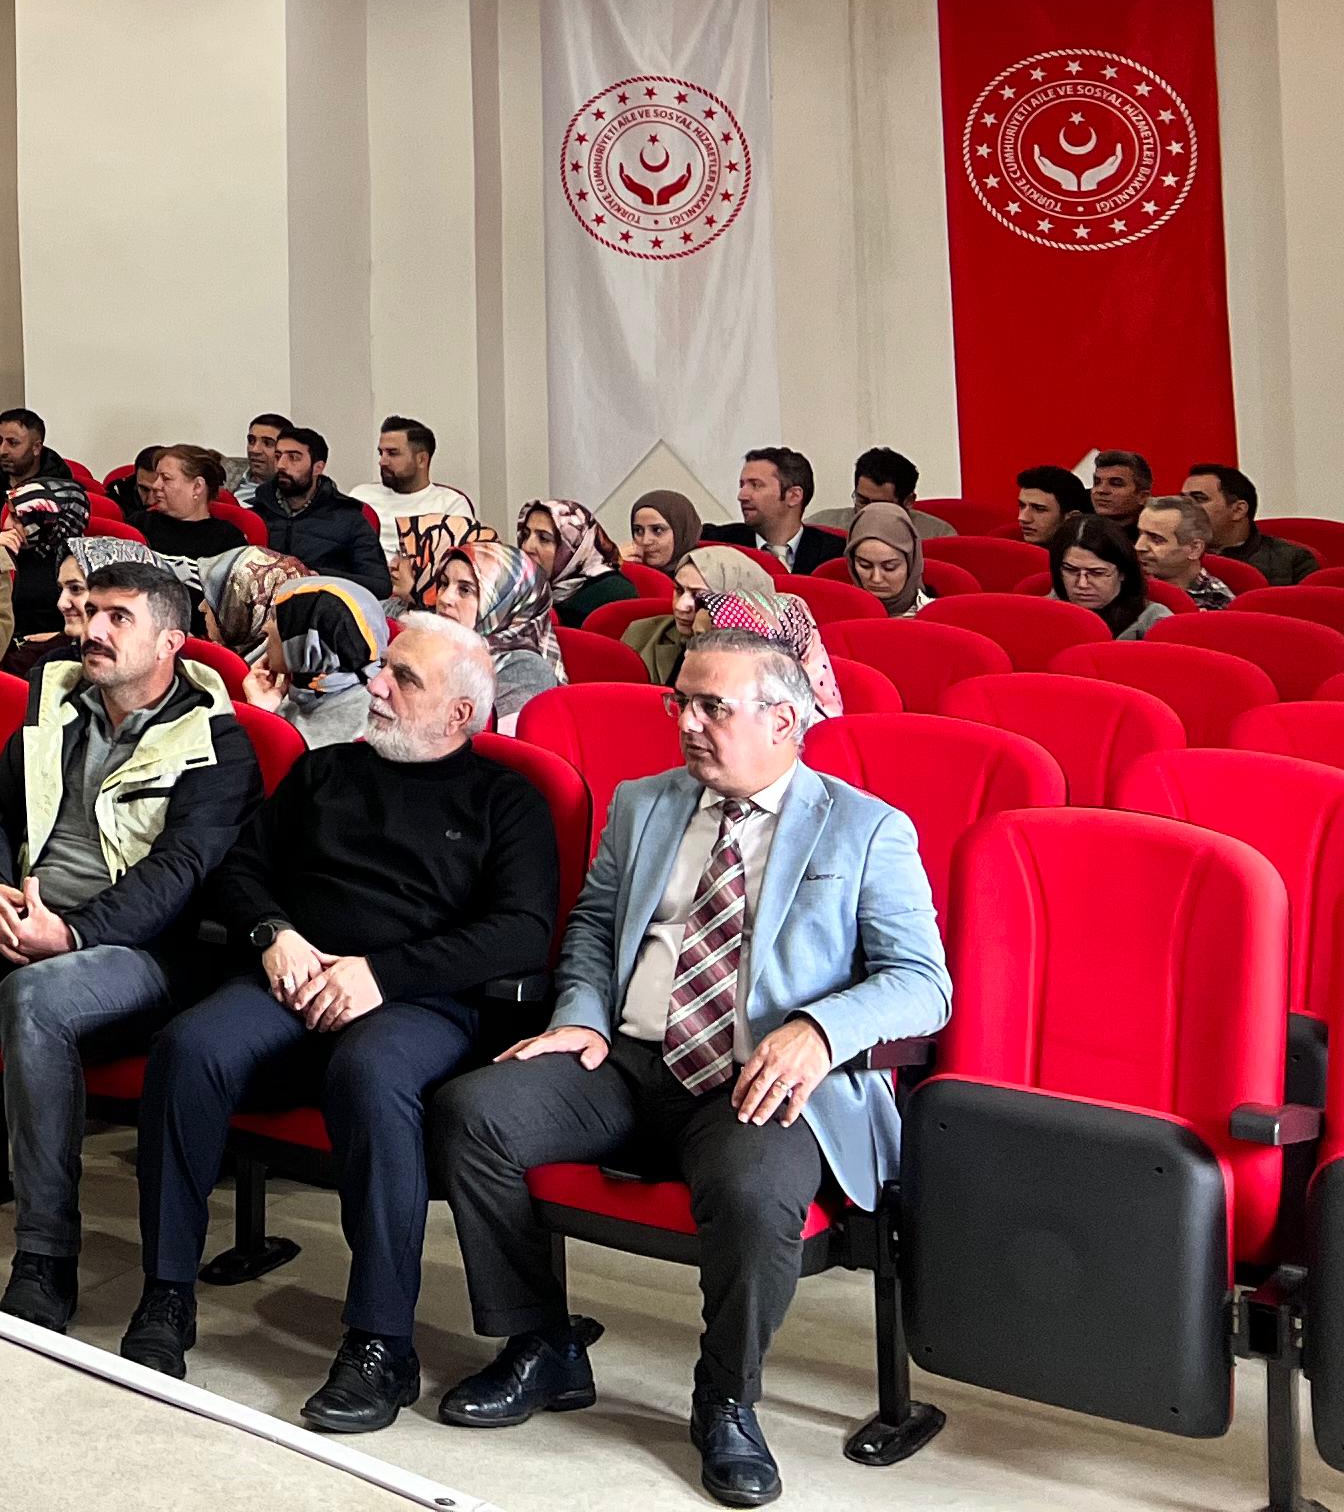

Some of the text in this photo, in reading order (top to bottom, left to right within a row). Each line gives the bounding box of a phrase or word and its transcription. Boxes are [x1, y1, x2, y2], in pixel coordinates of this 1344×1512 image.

[593, 109, 718, 225] TÜRKİYE CUMHURİYETİ AİLE VE SOSYAL HİZMETLER BAKANLIĞI
[1003, 85, 1154, 212] TÜRKİYE CUMHURİYETİ AİLE VE SOSYAL HİZMETLER BAKANLIĞI
